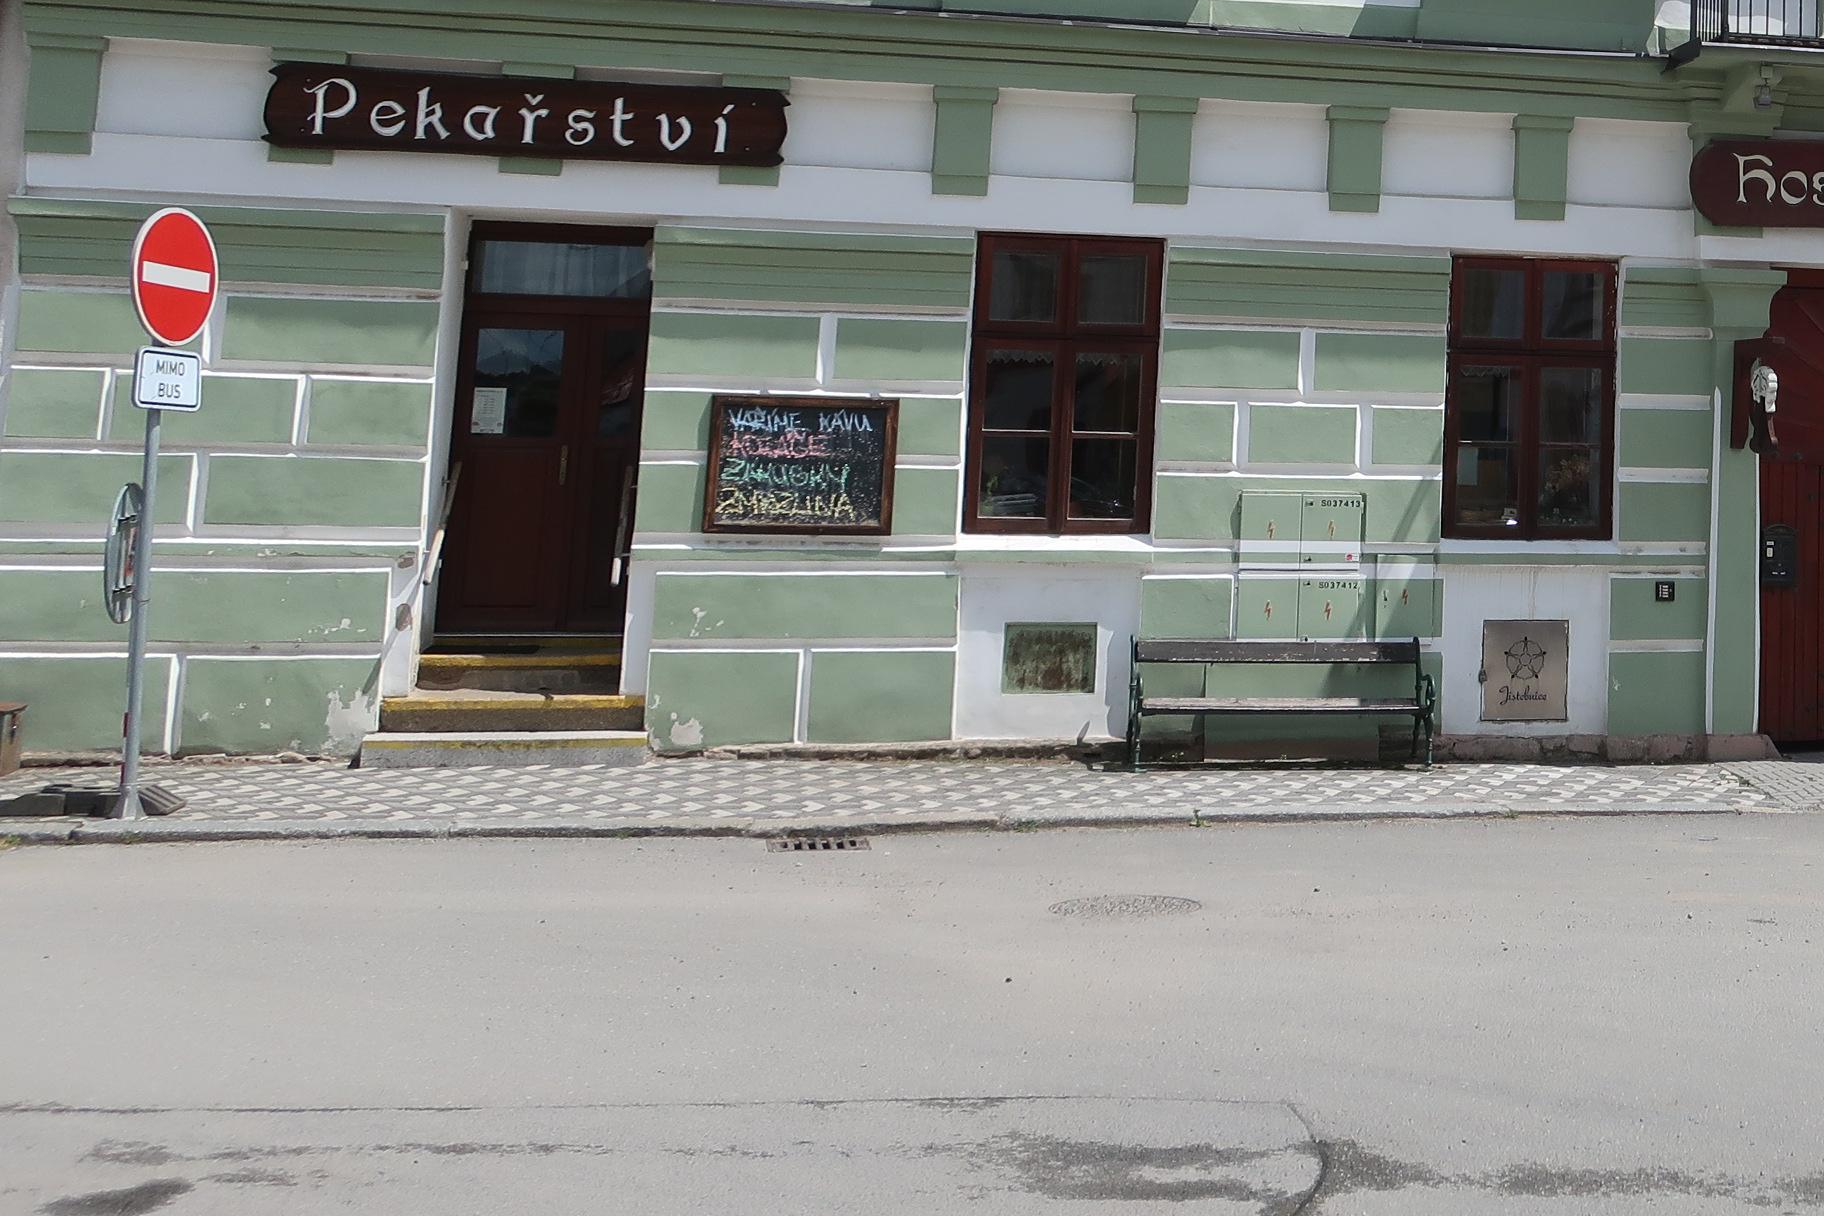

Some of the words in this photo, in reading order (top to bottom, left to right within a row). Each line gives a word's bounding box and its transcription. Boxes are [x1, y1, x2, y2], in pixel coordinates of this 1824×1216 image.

[303, 77, 735, 154] Pekařství
[156, 360, 186, 377] MIMO
[158, 383, 181, 399] BUS
[818, 408, 874, 432] KÁVU
